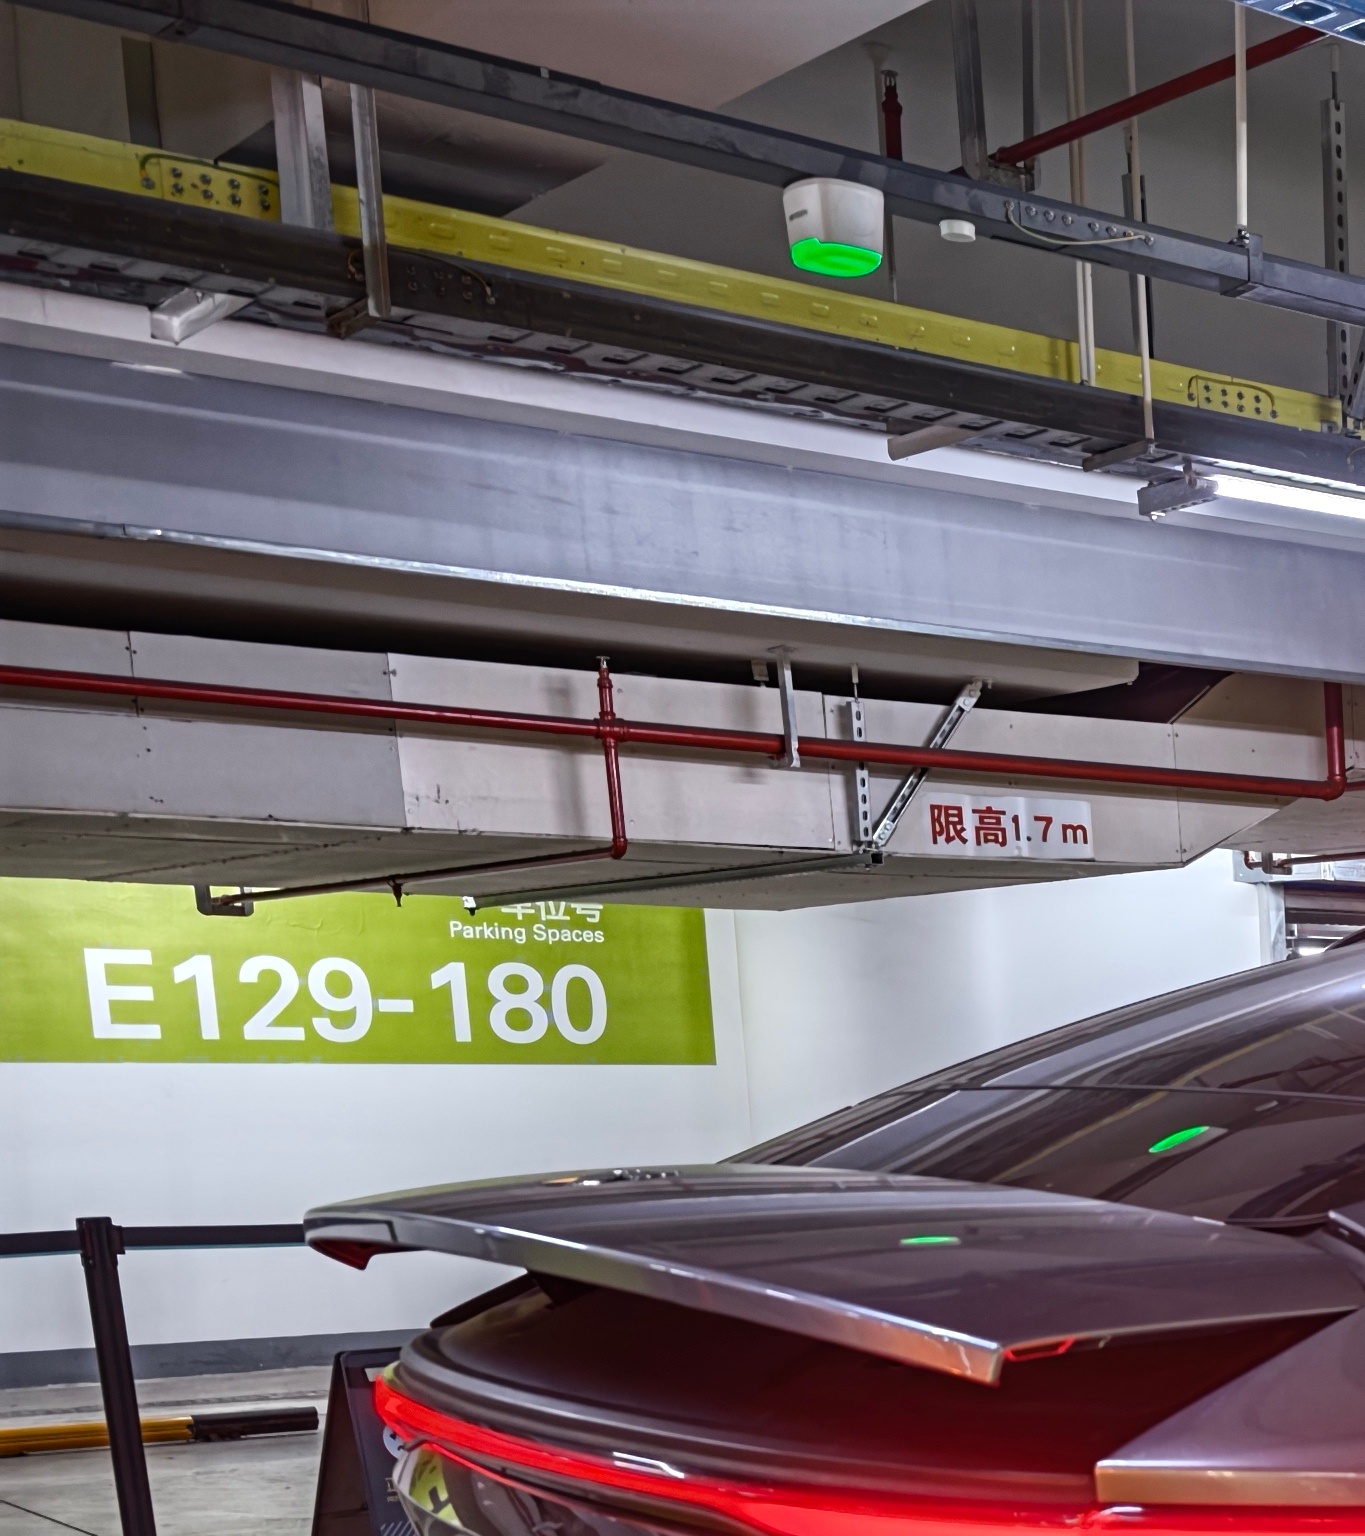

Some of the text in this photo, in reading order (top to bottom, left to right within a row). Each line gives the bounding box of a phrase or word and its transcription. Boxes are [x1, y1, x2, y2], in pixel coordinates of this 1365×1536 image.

[449, 920, 605, 945] Parking Spaces
[83, 948, 607, 1044] E129-180
